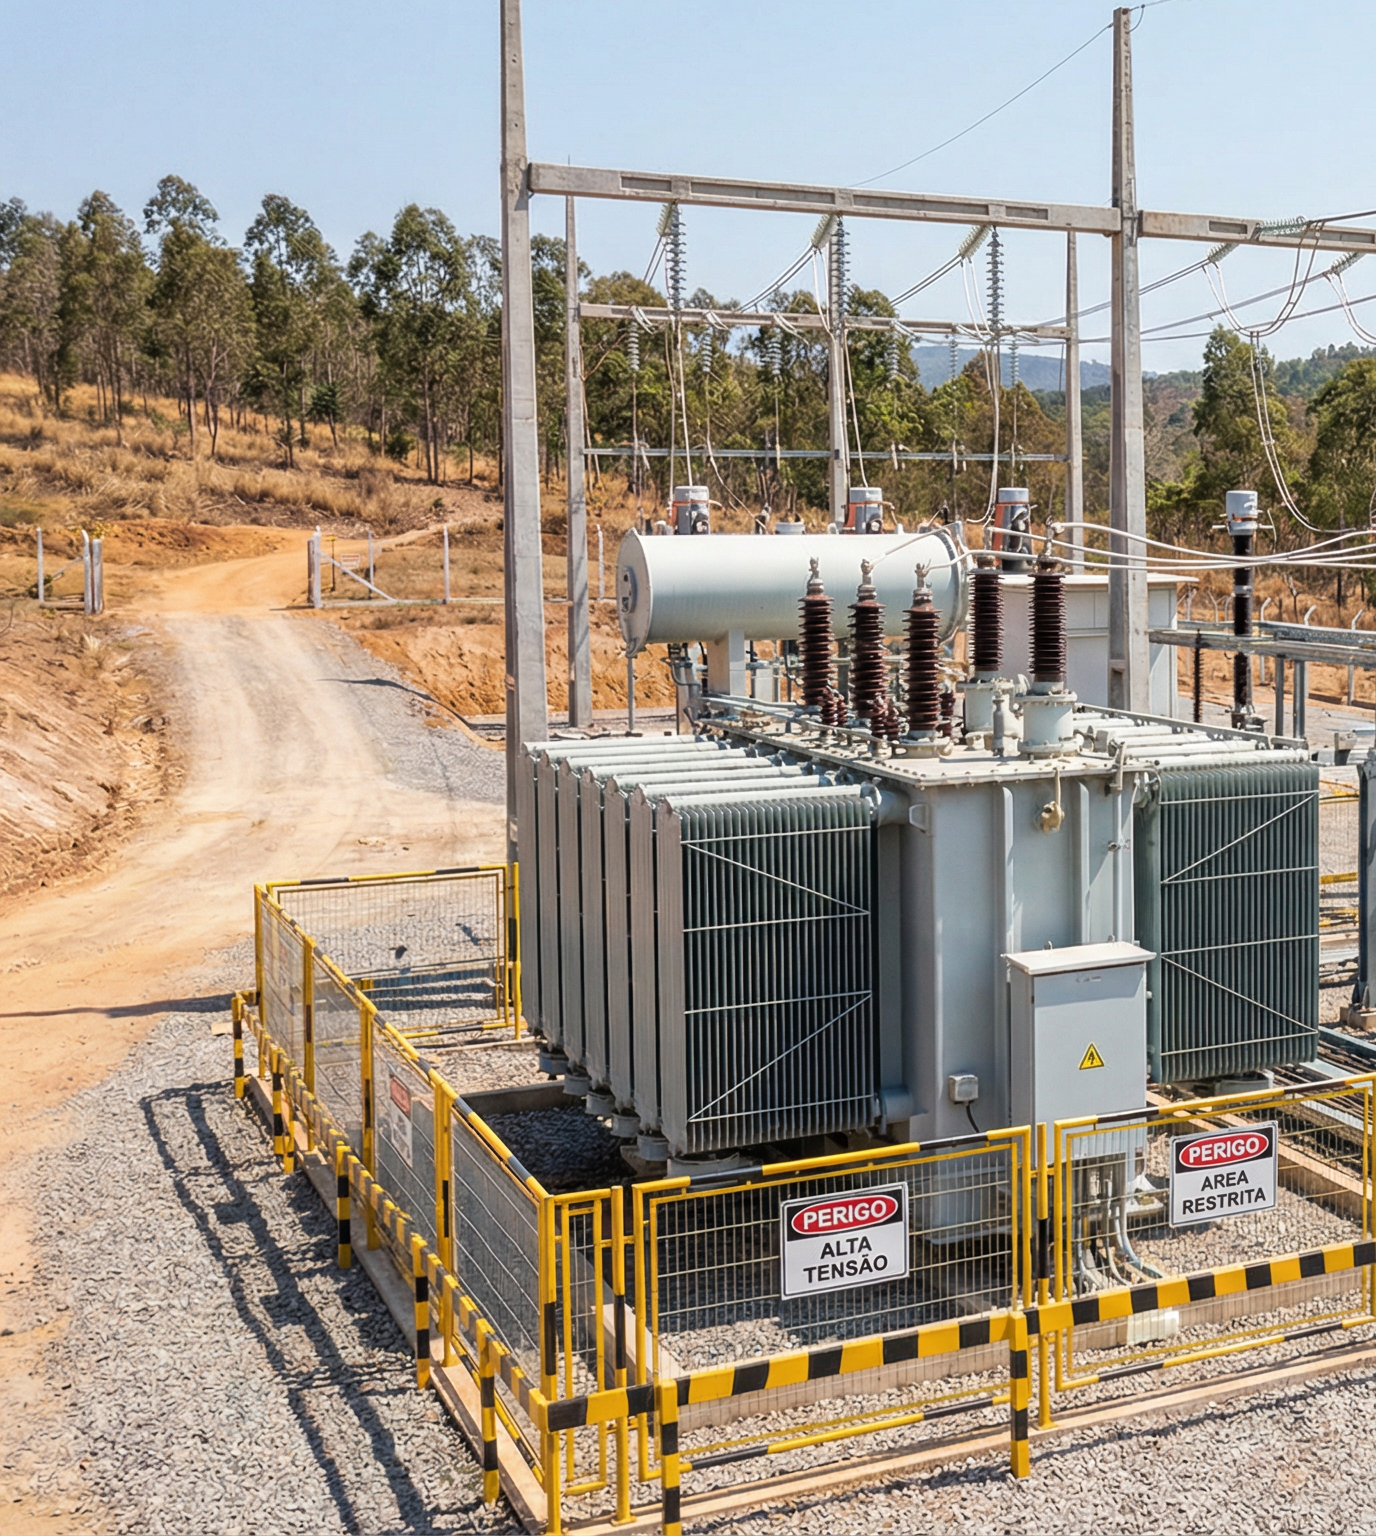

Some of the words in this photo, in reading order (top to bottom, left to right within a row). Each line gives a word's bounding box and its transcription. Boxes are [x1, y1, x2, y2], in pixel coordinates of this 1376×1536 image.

[1189, 1137, 1260, 1163] PERIGO
[1200, 1170, 1249, 1191] AREA
[1182, 1187, 1266, 1215] RESTRITA
[803, 1200, 887, 1230] PERIGO
[820, 1236, 872, 1259] ALTA
[803, 1254, 888, 1283] TENSÃO
